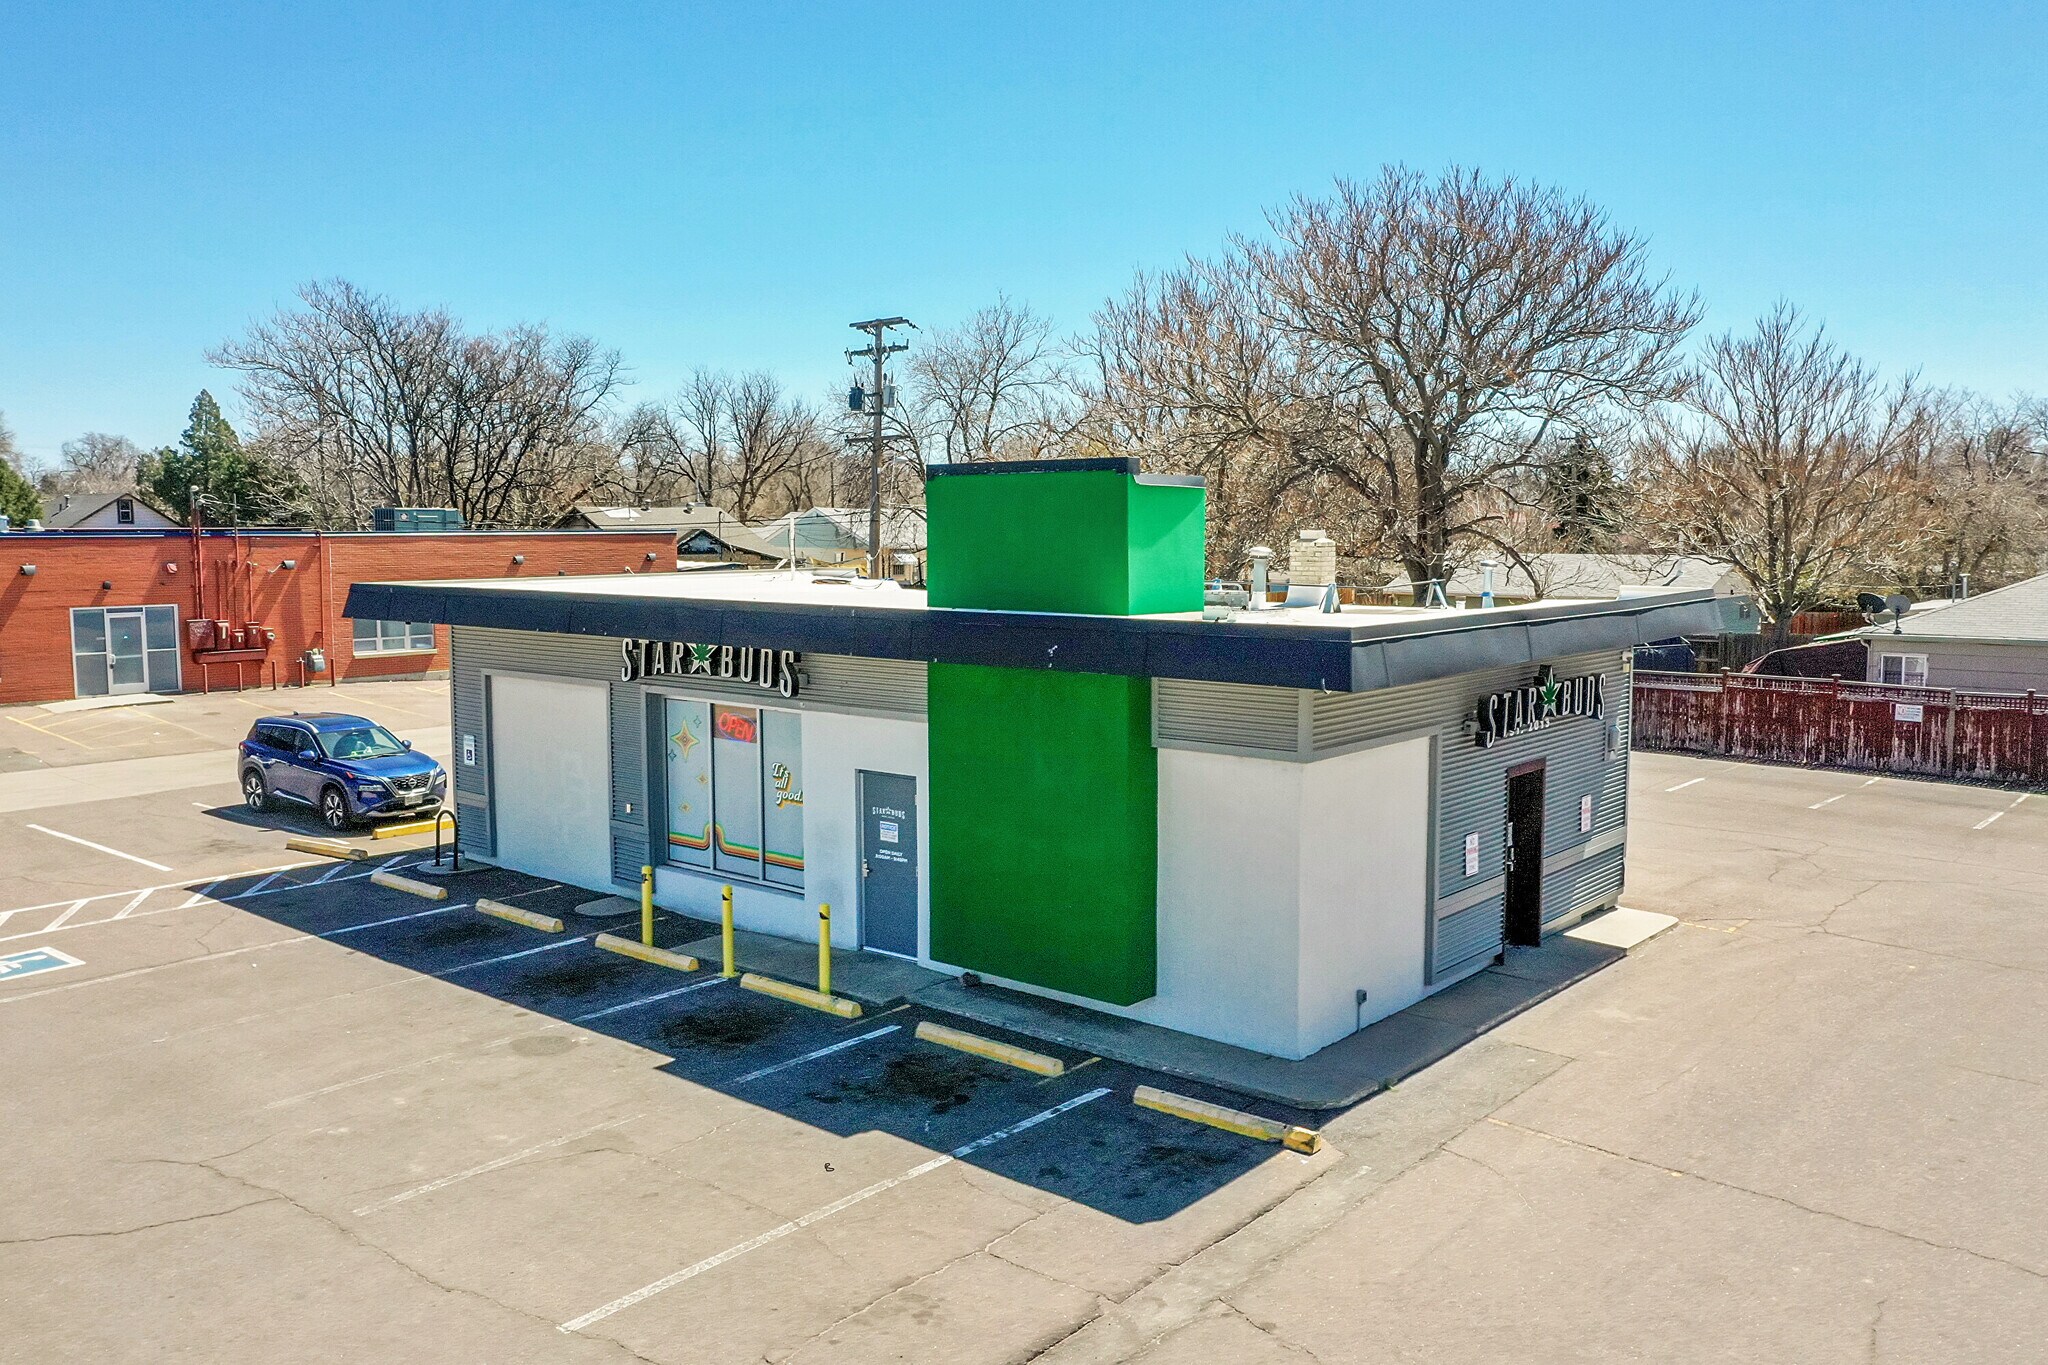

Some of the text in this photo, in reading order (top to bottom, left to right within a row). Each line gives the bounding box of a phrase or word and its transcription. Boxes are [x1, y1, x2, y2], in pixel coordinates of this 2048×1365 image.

[621, 638, 794, 698] STAR BUDS
[1486, 673, 1606, 749] STAR BUDS
[718, 712, 755, 743] OPEN
[772, 762, 790, 778] It's
[775, 777, 788, 789] all
